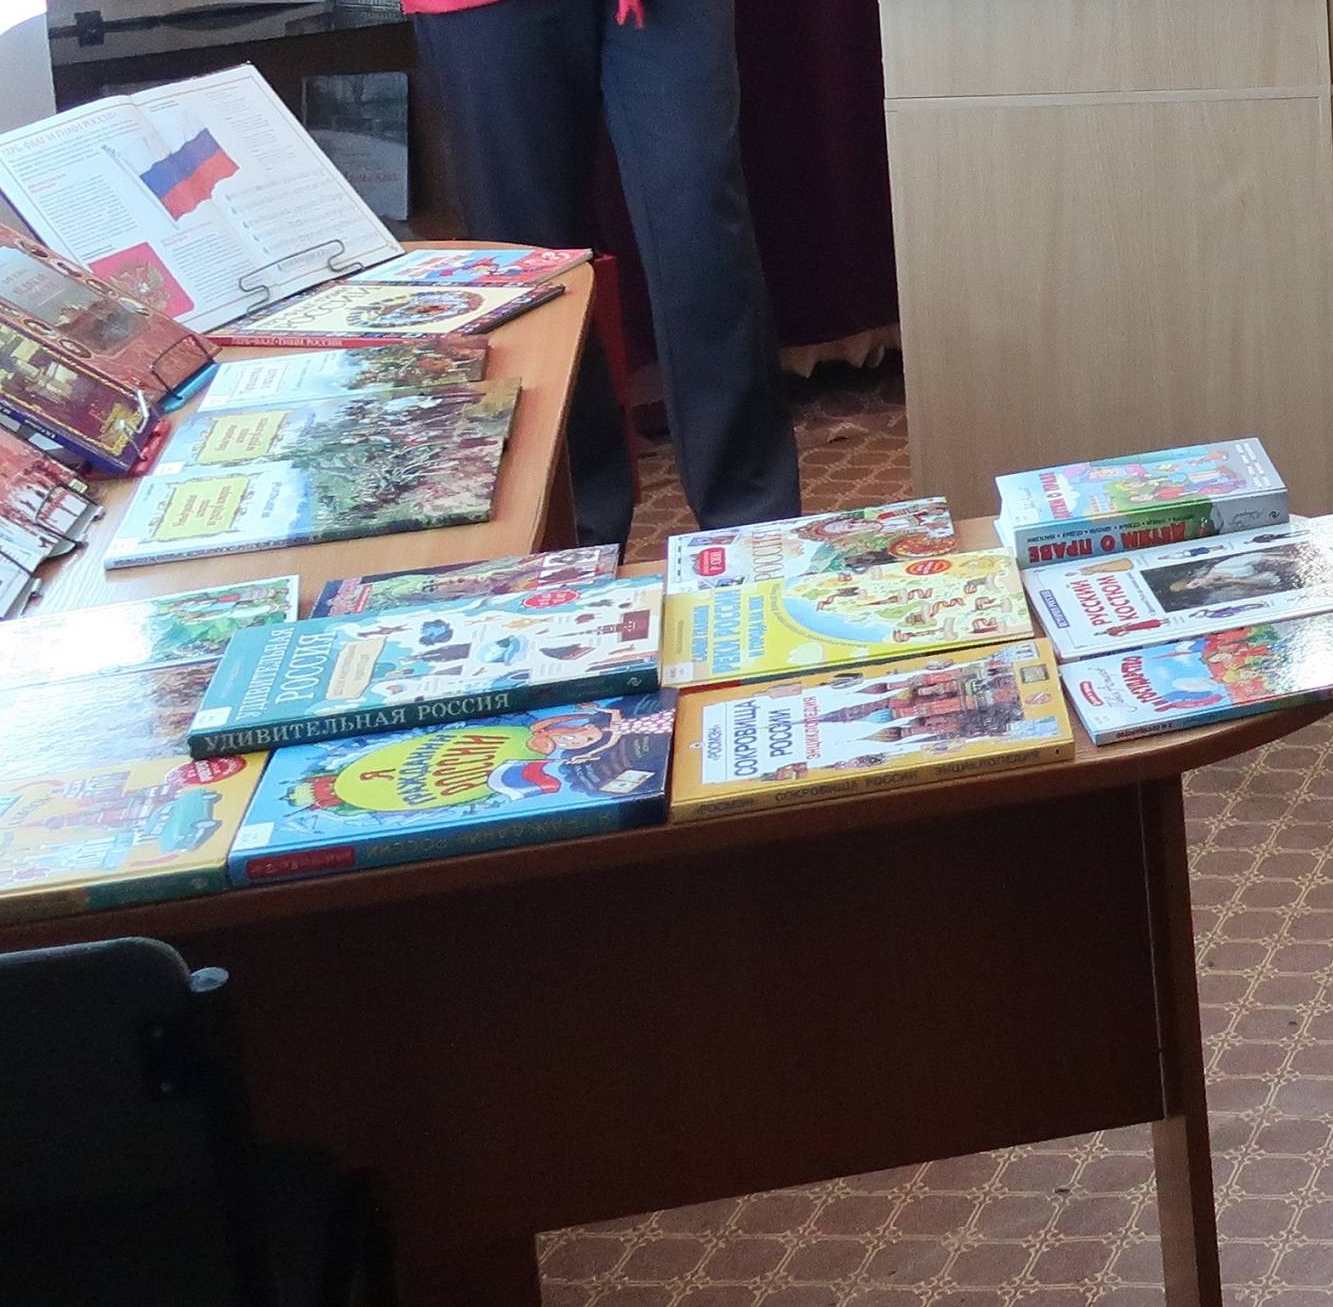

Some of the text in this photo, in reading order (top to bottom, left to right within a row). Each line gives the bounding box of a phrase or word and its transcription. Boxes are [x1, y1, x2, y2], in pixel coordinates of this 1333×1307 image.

[1028, 521, 1187, 564] ДЕТЯМ О ПРАВЕ
[1069, 579, 1110, 627] РУССКИЙ
[1098, 574, 1141, 622] КОСТЮМ
[711, 589, 742, 675] РЕКИ РОССИИ
[237, 626, 296, 721] УДИВИТЕЛЬНАЯ
[274, 630, 339, 705] РОССИЯ
[1120, 655, 1160, 703] ГОСУДАРСТВО
[204, 692, 511, 755] УДИВИТЕЛЬНАЯ РОССИЯ
[733, 699, 759, 777] СОКРОВИЩА
[768, 707, 793, 759] РОССИИ
[804, 693, 823, 761] ЭНЦИКЛОПЕДИЯ
[359, 767, 397, 784] Я
[396, 732, 456, 807] ГРАЖДАНИН
[430, 733, 512, 797] РОССИИ
[864, 768, 920, 789] РОССИИ
